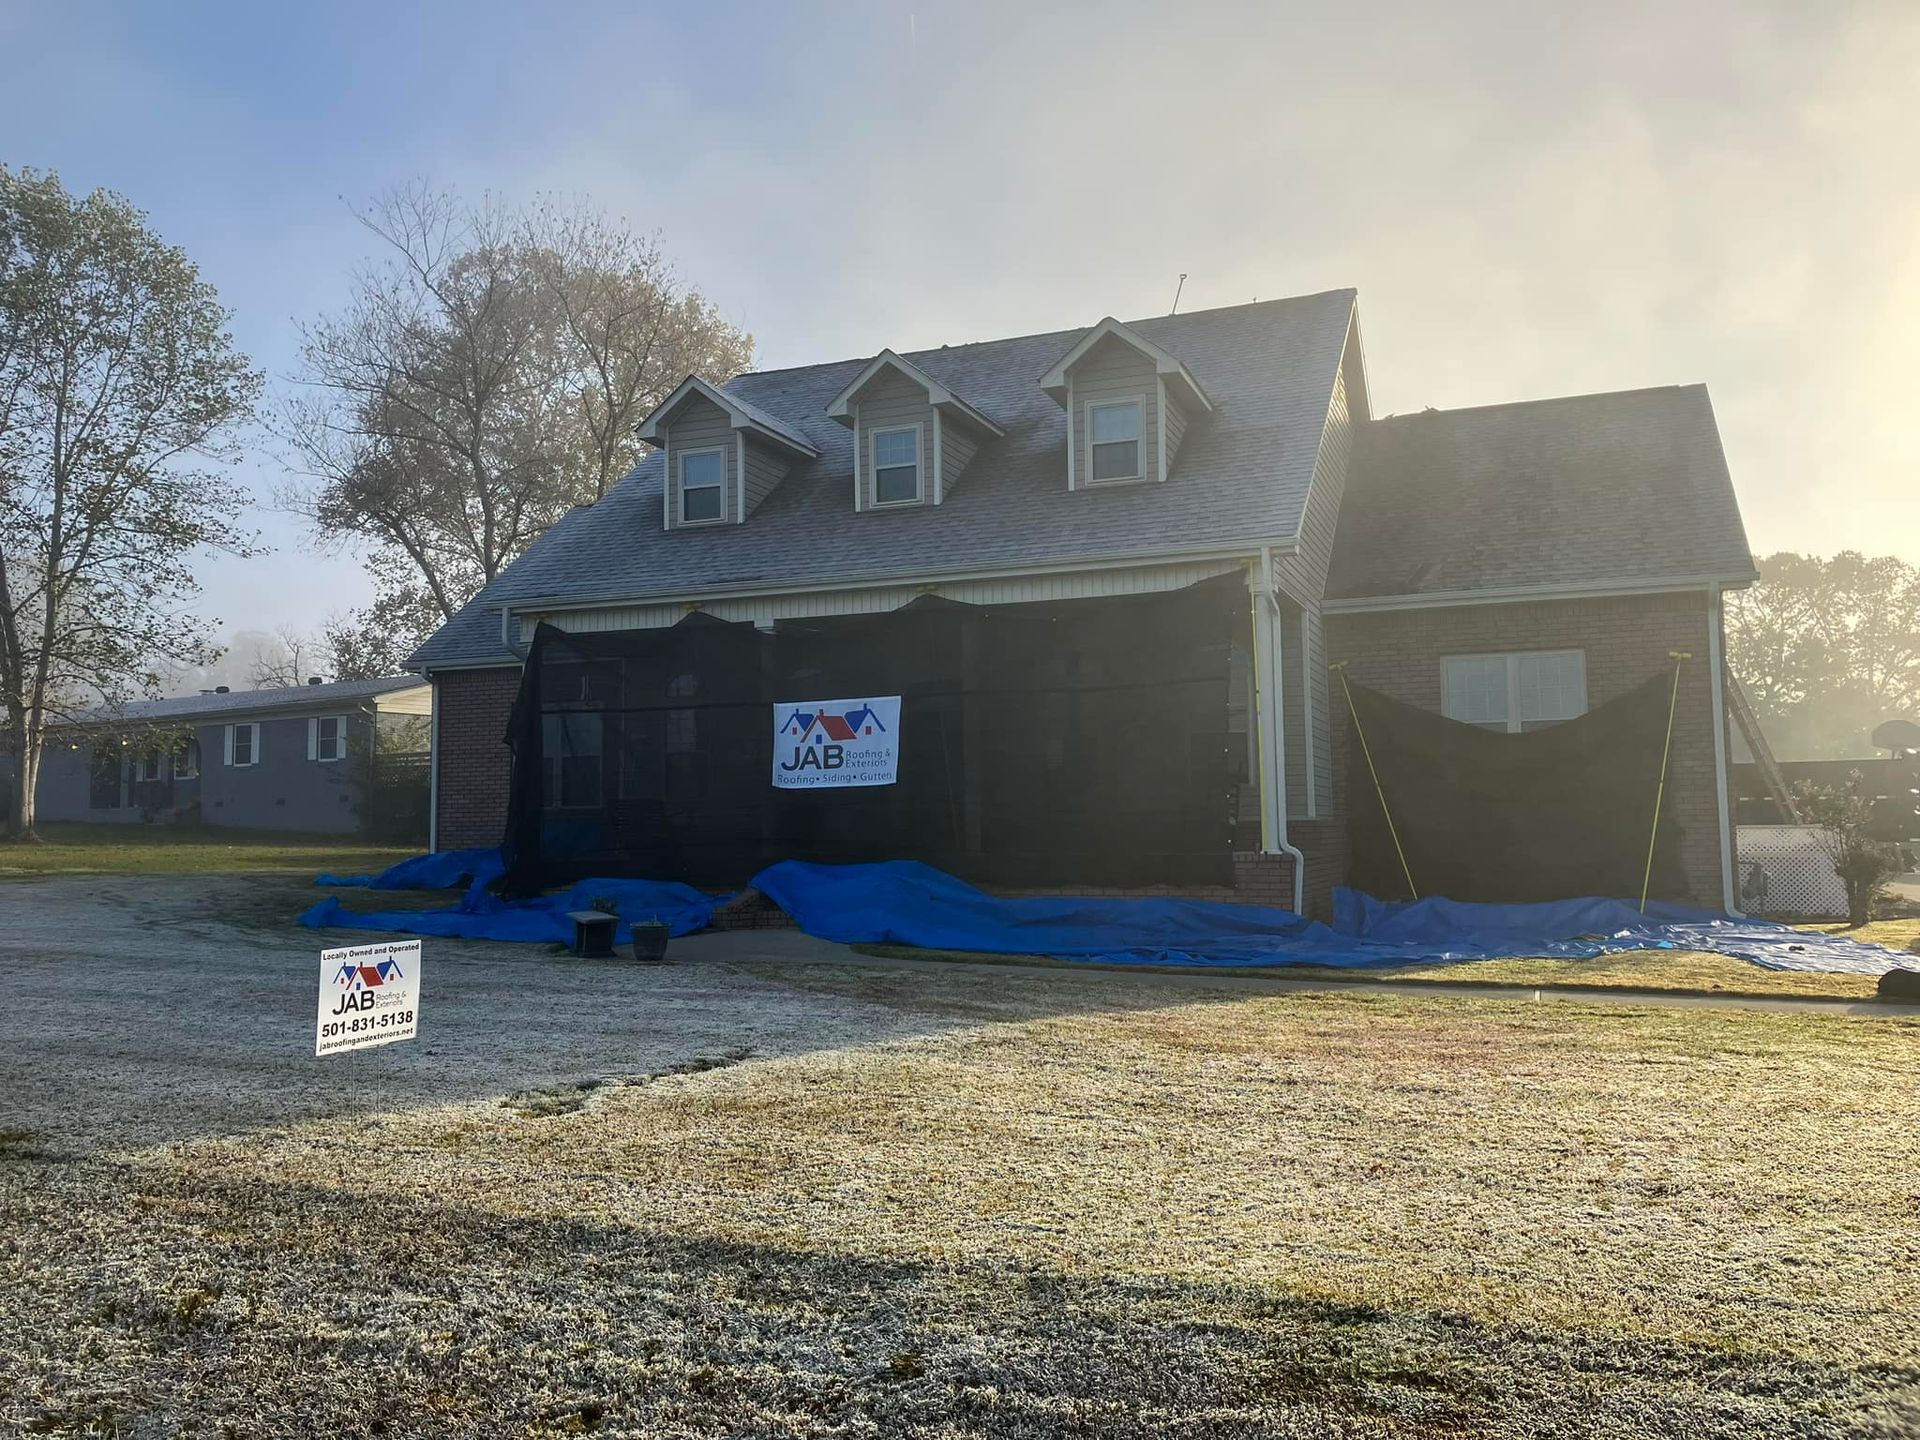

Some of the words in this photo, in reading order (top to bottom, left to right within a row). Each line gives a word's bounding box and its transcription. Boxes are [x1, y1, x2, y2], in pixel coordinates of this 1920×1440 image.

[781, 745, 844, 771] JAB
[846, 750, 883, 760] Roofing
[846, 759, 887, 768] Exteriors
[778, 774, 815, 785] Roofing
[823, 772, 851, 783] Siding
[323, 951, 347, 960] Locally
[349, 948, 372, 957] Owned
[374, 946, 387, 954] and
[388, 943, 419, 953] Operated
[332, 990, 375, 1015] JAB
[376, 992, 400, 1001] Roofing
[402, 990, 407, 998] &
[376, 1000, 403, 1009] Exteriors
[322, 1010, 413, 1037] 501-831-5138
[319, 1027, 413, 1051] jabroofingandexteriors.net
